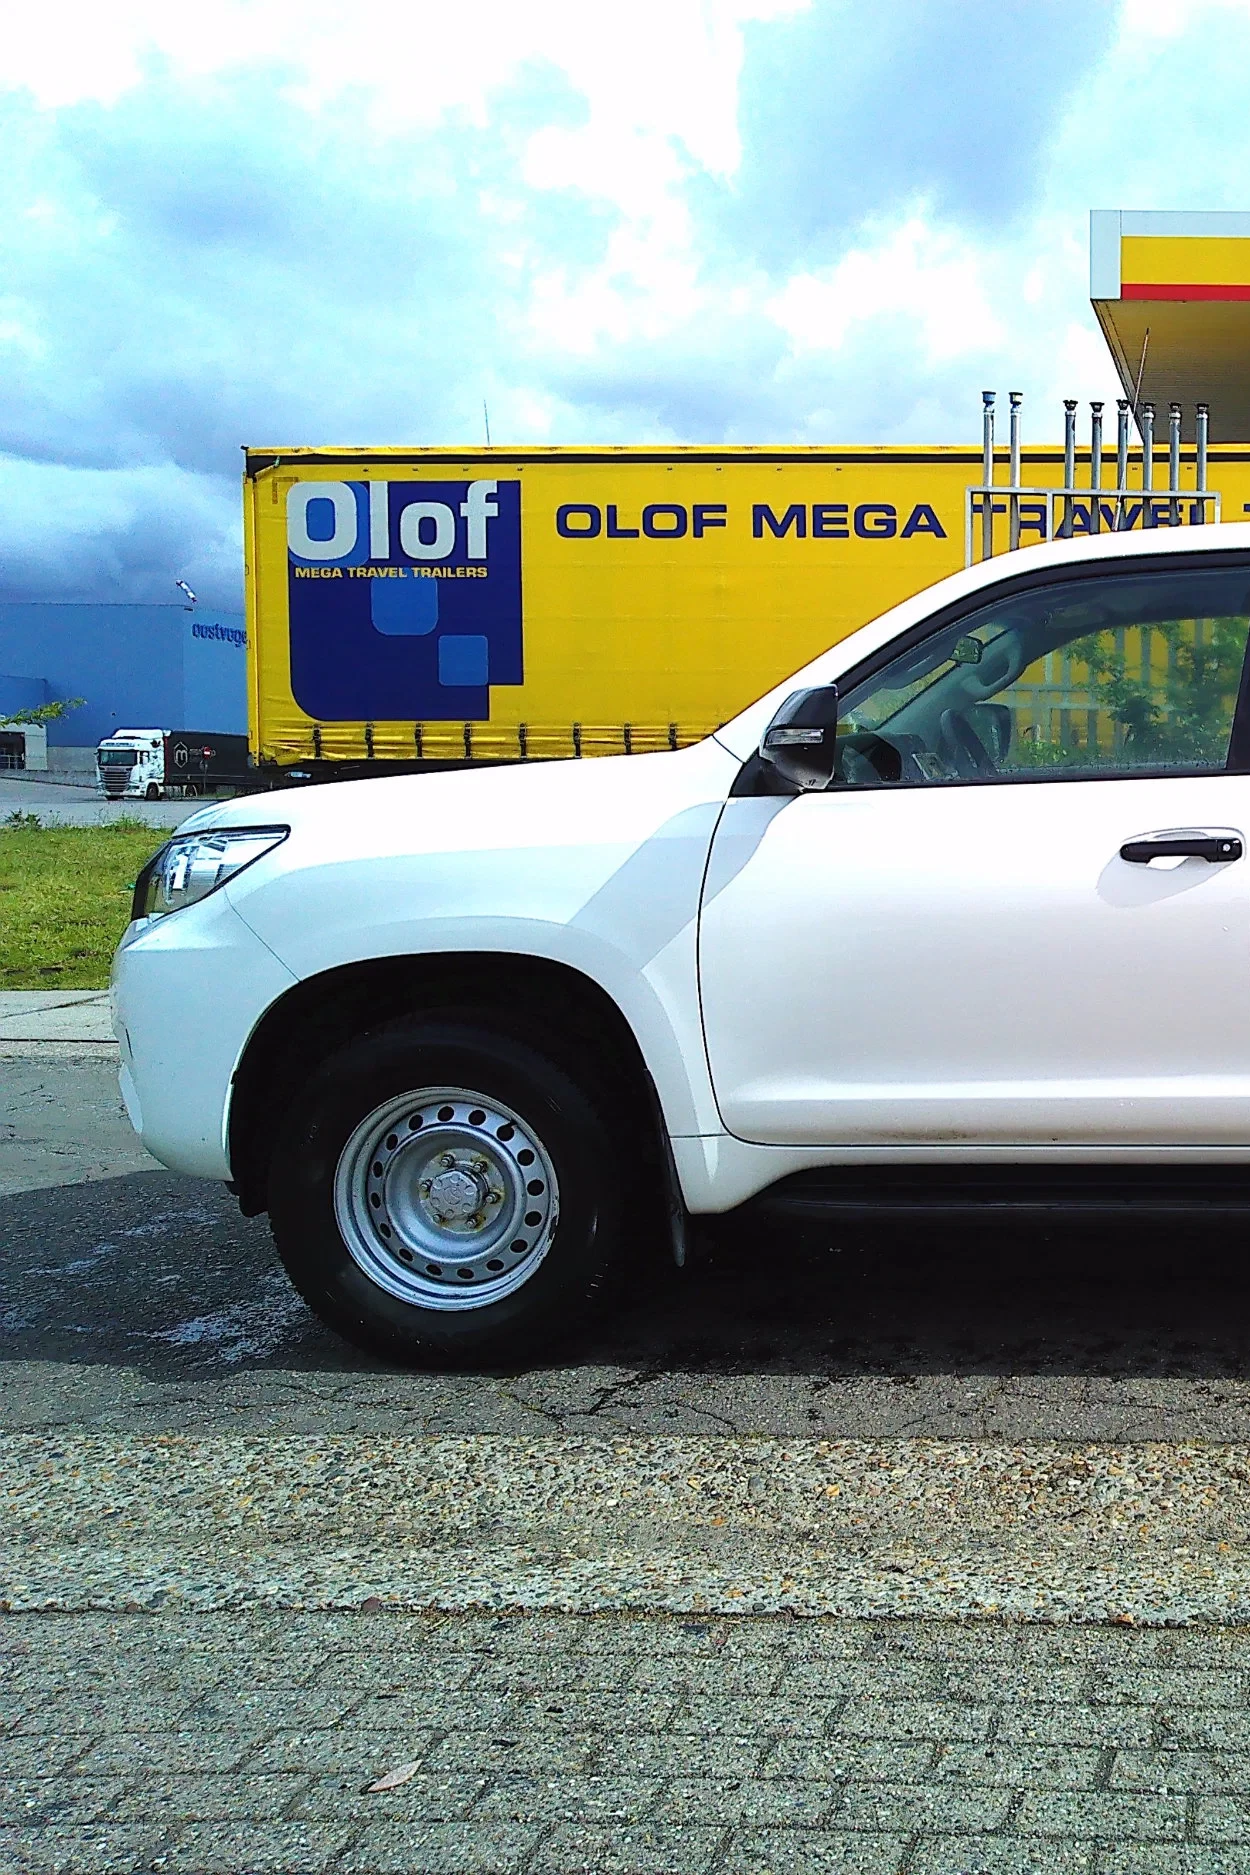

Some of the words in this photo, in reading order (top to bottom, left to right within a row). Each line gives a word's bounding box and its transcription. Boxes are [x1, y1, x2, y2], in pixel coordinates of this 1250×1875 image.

[286, 480, 498, 561] Olof
[556, 504, 728, 538] OLOF
[752, 505, 947, 538] MEGA
[295, 567, 342, 578] MEGA
[347, 567, 407, 578] TRAVEL
[411, 567, 488, 578] TRAILERS
